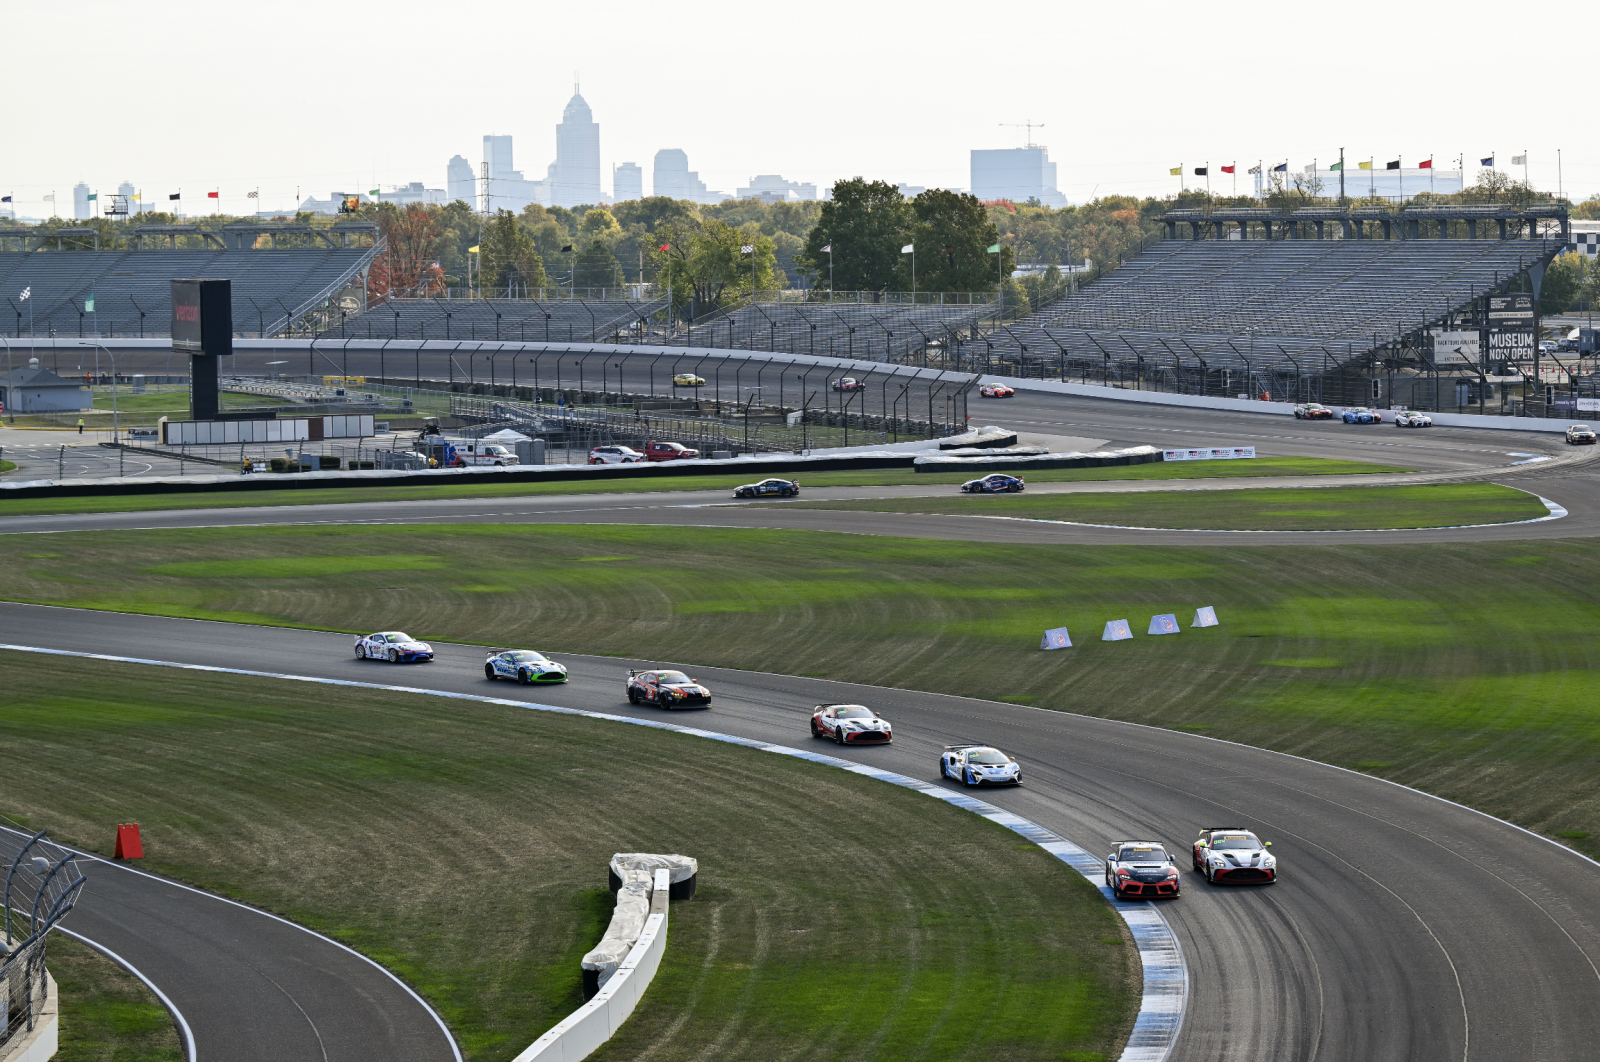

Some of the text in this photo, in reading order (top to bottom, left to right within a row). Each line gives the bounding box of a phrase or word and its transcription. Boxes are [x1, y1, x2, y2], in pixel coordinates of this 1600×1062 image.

[1489, 333, 1533, 347] MUSEUM
[1490, 347, 1533, 360] NOW OPEN
